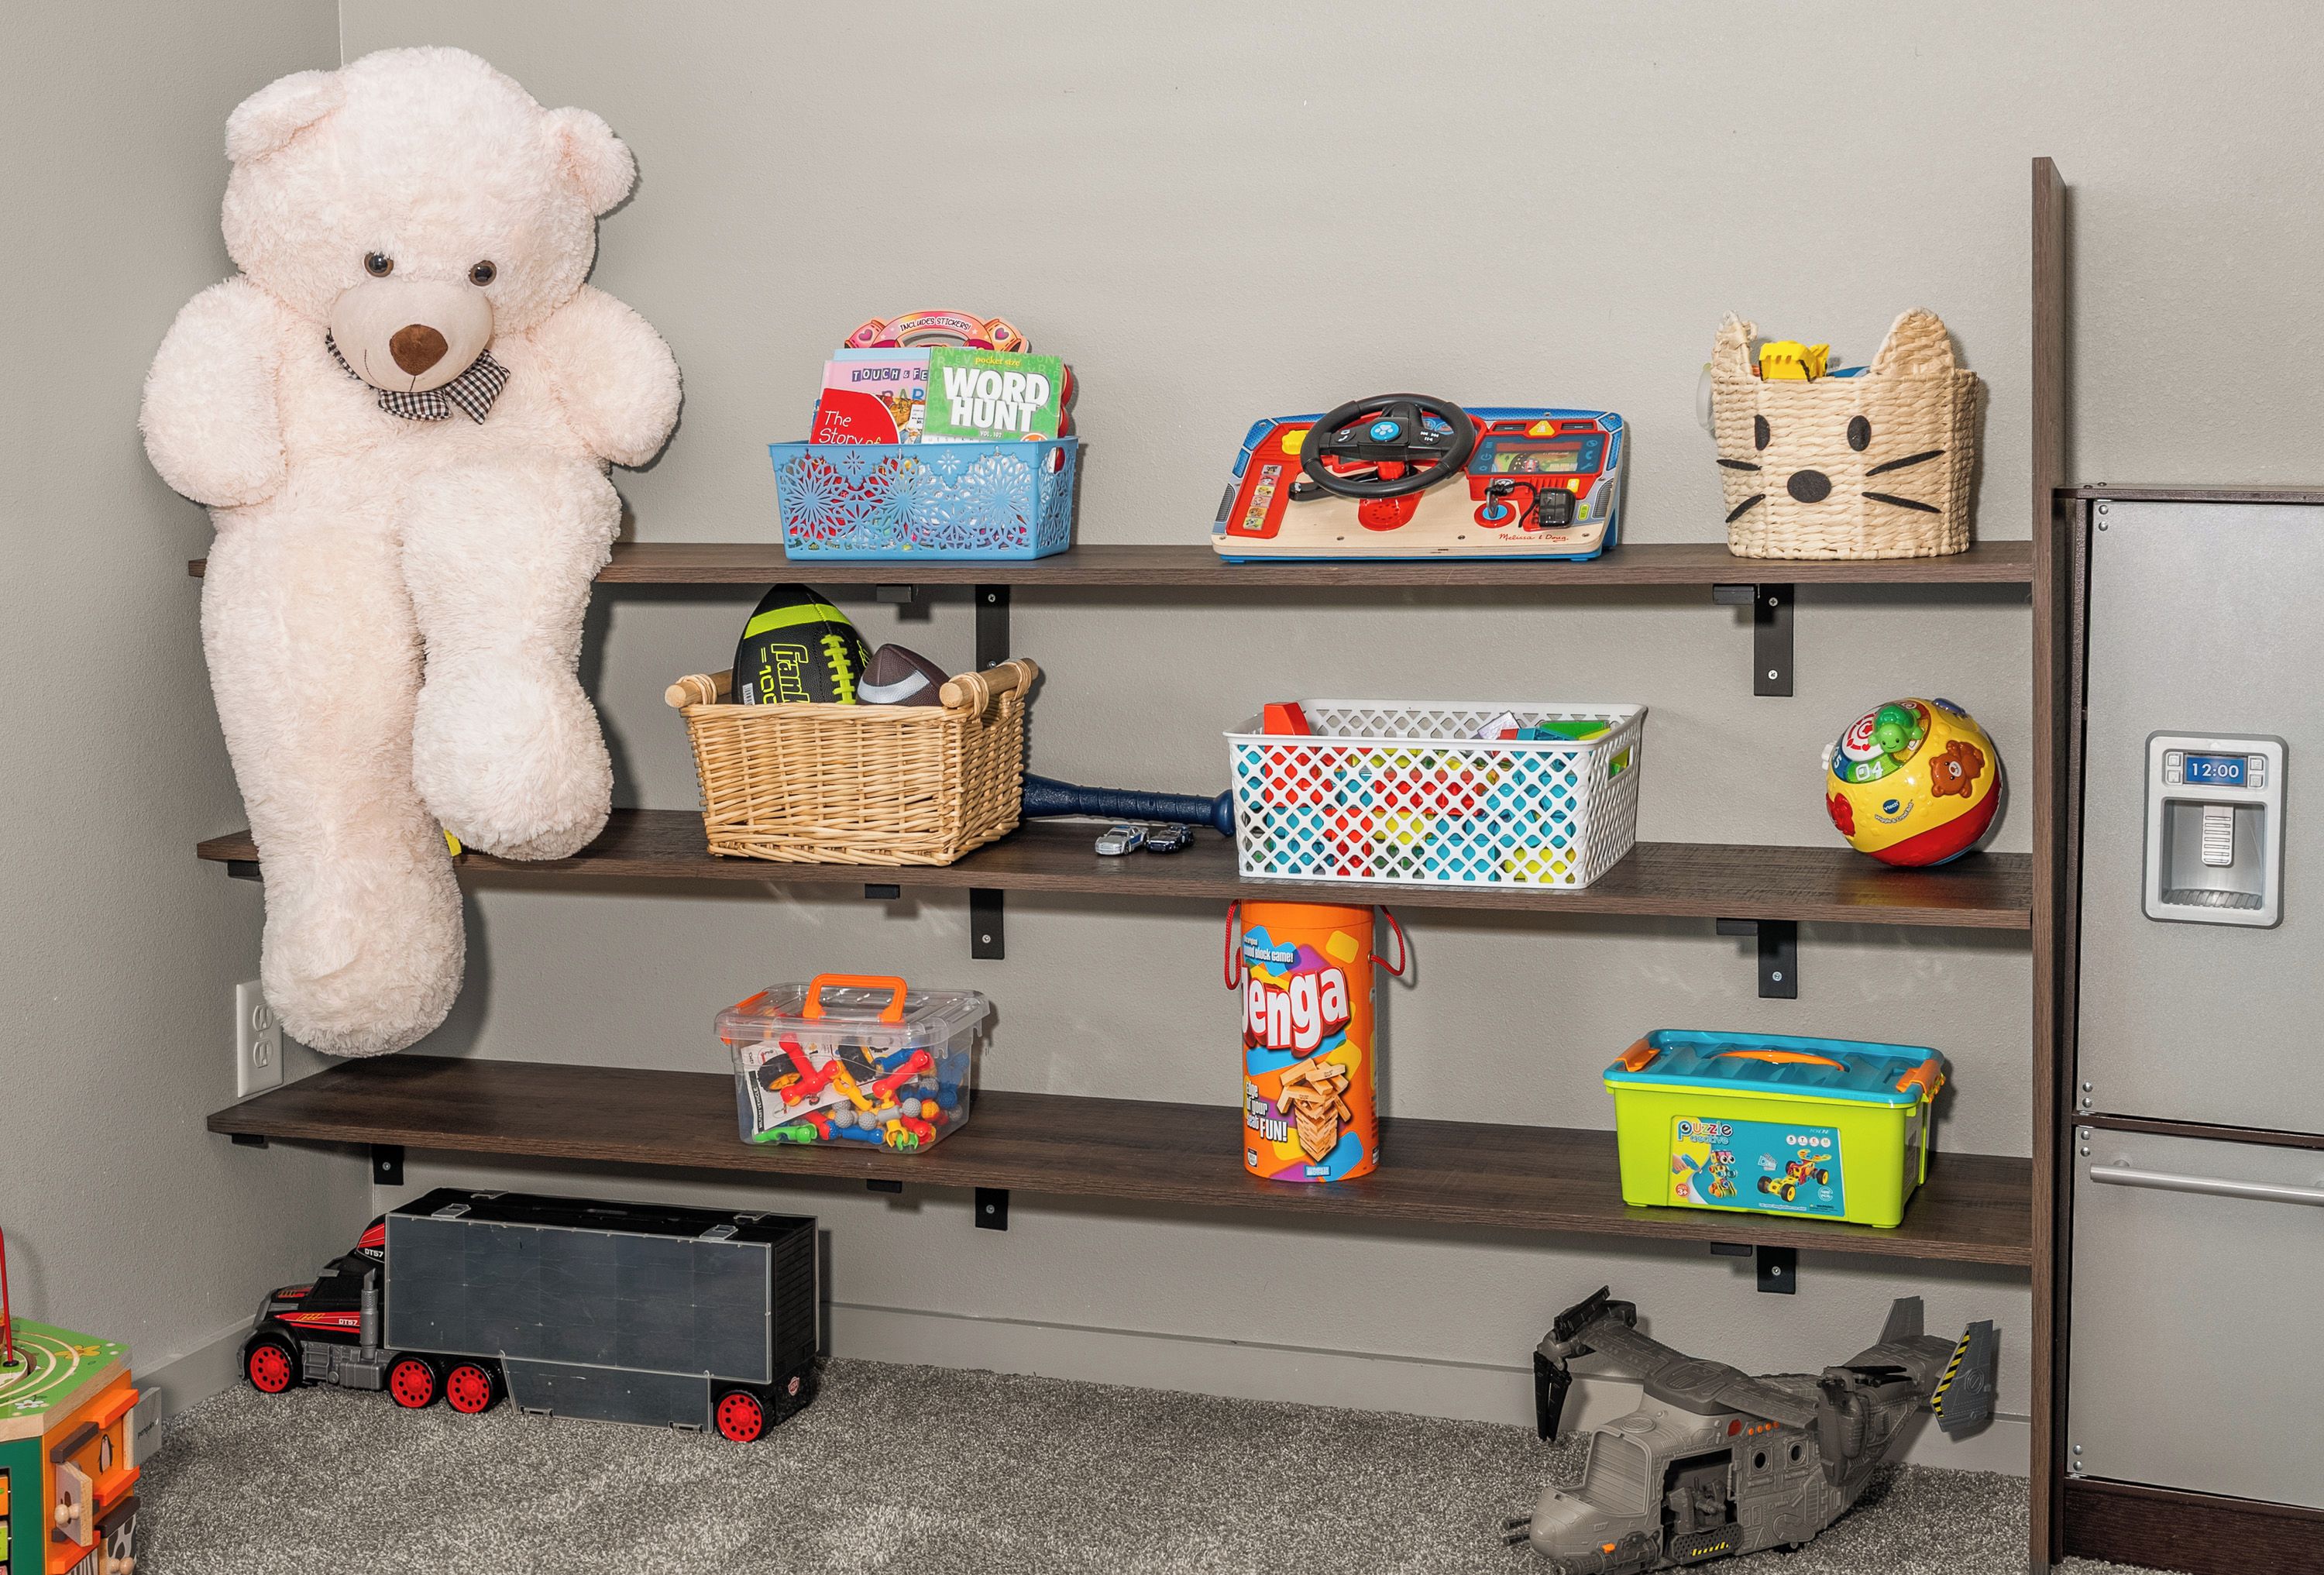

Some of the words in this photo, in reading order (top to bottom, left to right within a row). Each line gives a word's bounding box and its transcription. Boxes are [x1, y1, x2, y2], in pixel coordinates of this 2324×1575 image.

[900, 318, 935, 331] INCLUDES
[937, 318, 971, 330] STICKERS!
[975, 356, 1002, 366] pocket
[853, 368, 900, 381] TOUCH
[944, 366, 1050, 408] WORD
[825, 411, 851, 427] The
[951, 396, 1037, 432] HUNT
[819, 428, 863, 444] Story
[2192, 762, 2240, 779] 12:00
[1241, 965, 1349, 1051] Jenga
[754, 1087, 762, 1109] VEHICLE
[1260, 1117, 1288, 1142] FUN!
[364, 1247, 384, 1258] DT57
